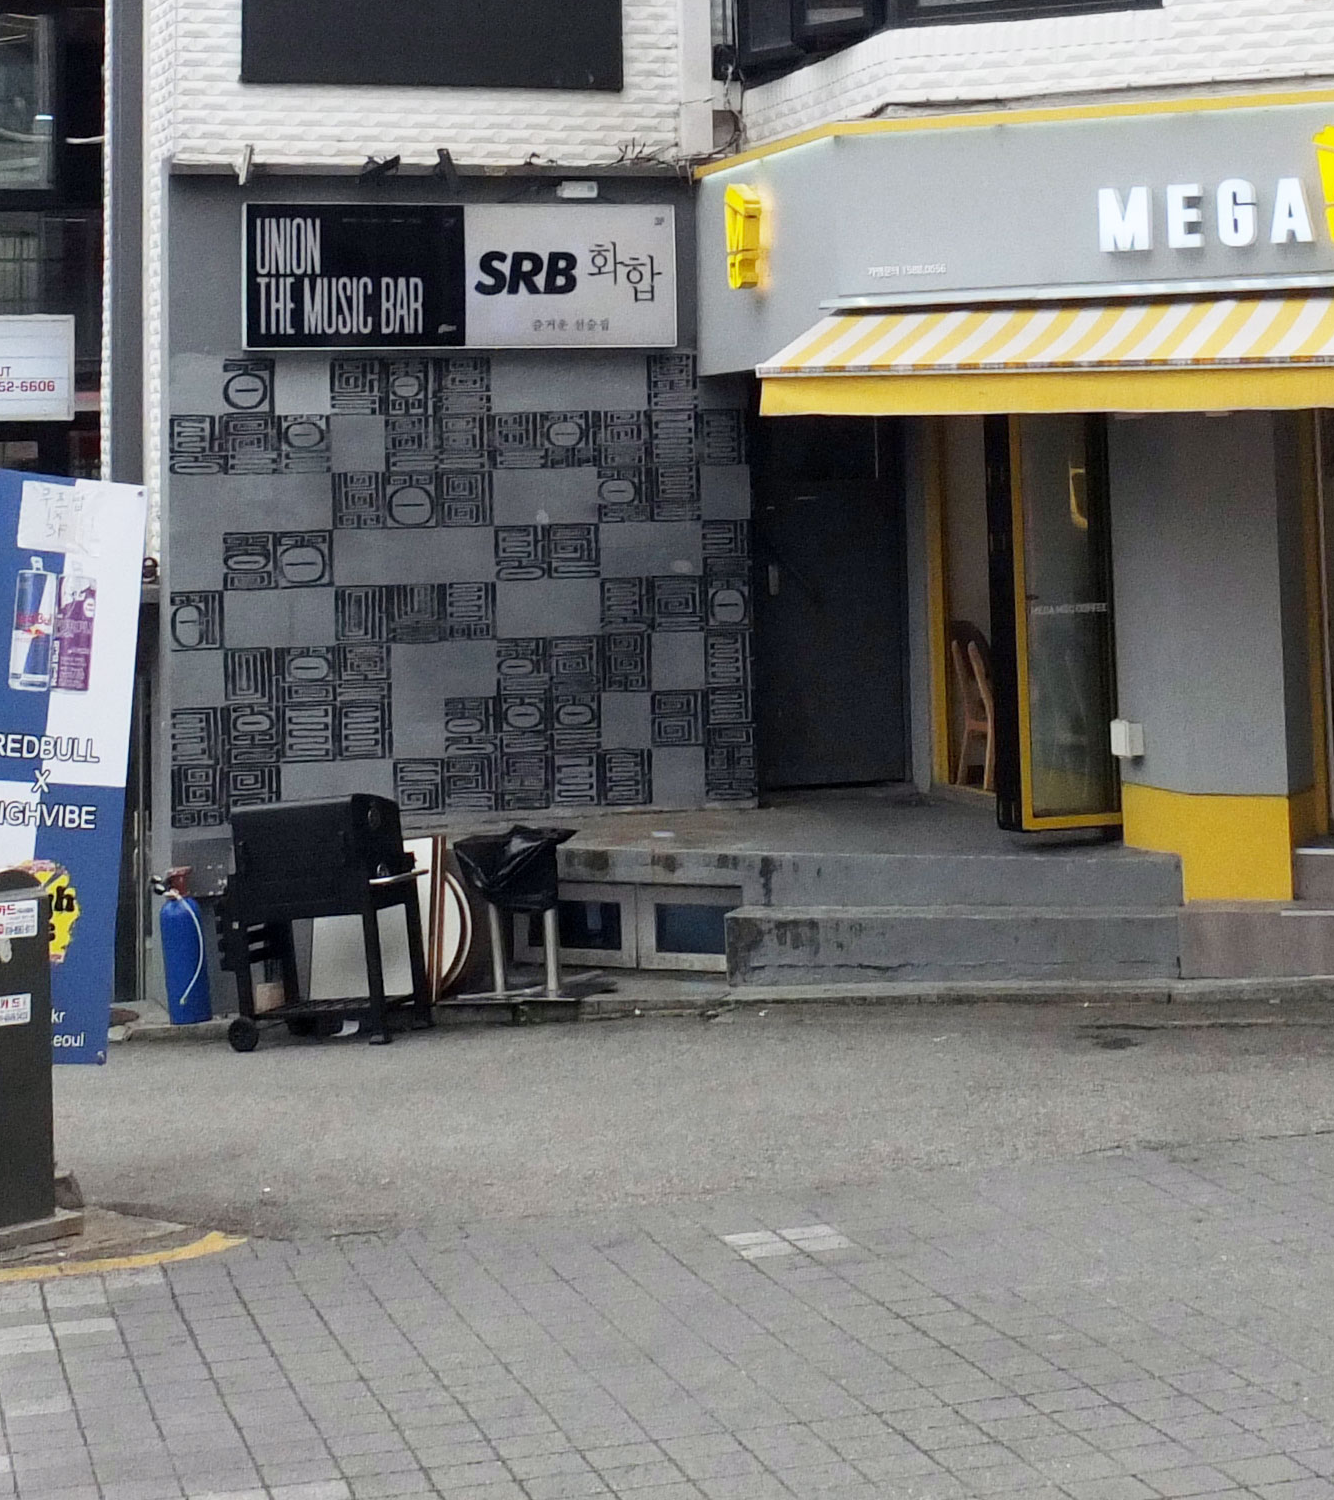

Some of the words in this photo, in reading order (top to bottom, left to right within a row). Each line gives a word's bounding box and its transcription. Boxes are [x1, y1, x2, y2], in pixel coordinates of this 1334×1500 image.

[1098, 177, 1315, 252] MEGA
[255, 217, 321, 275] UNION
[474, 251, 578, 296] SRB
[587, 241, 663, 303] 화합
[257, 277, 296, 335] THE
[303, 277, 373, 335] MUSIC
[380, 277, 424, 335] BAR
[31, 768, 51, 793] X
